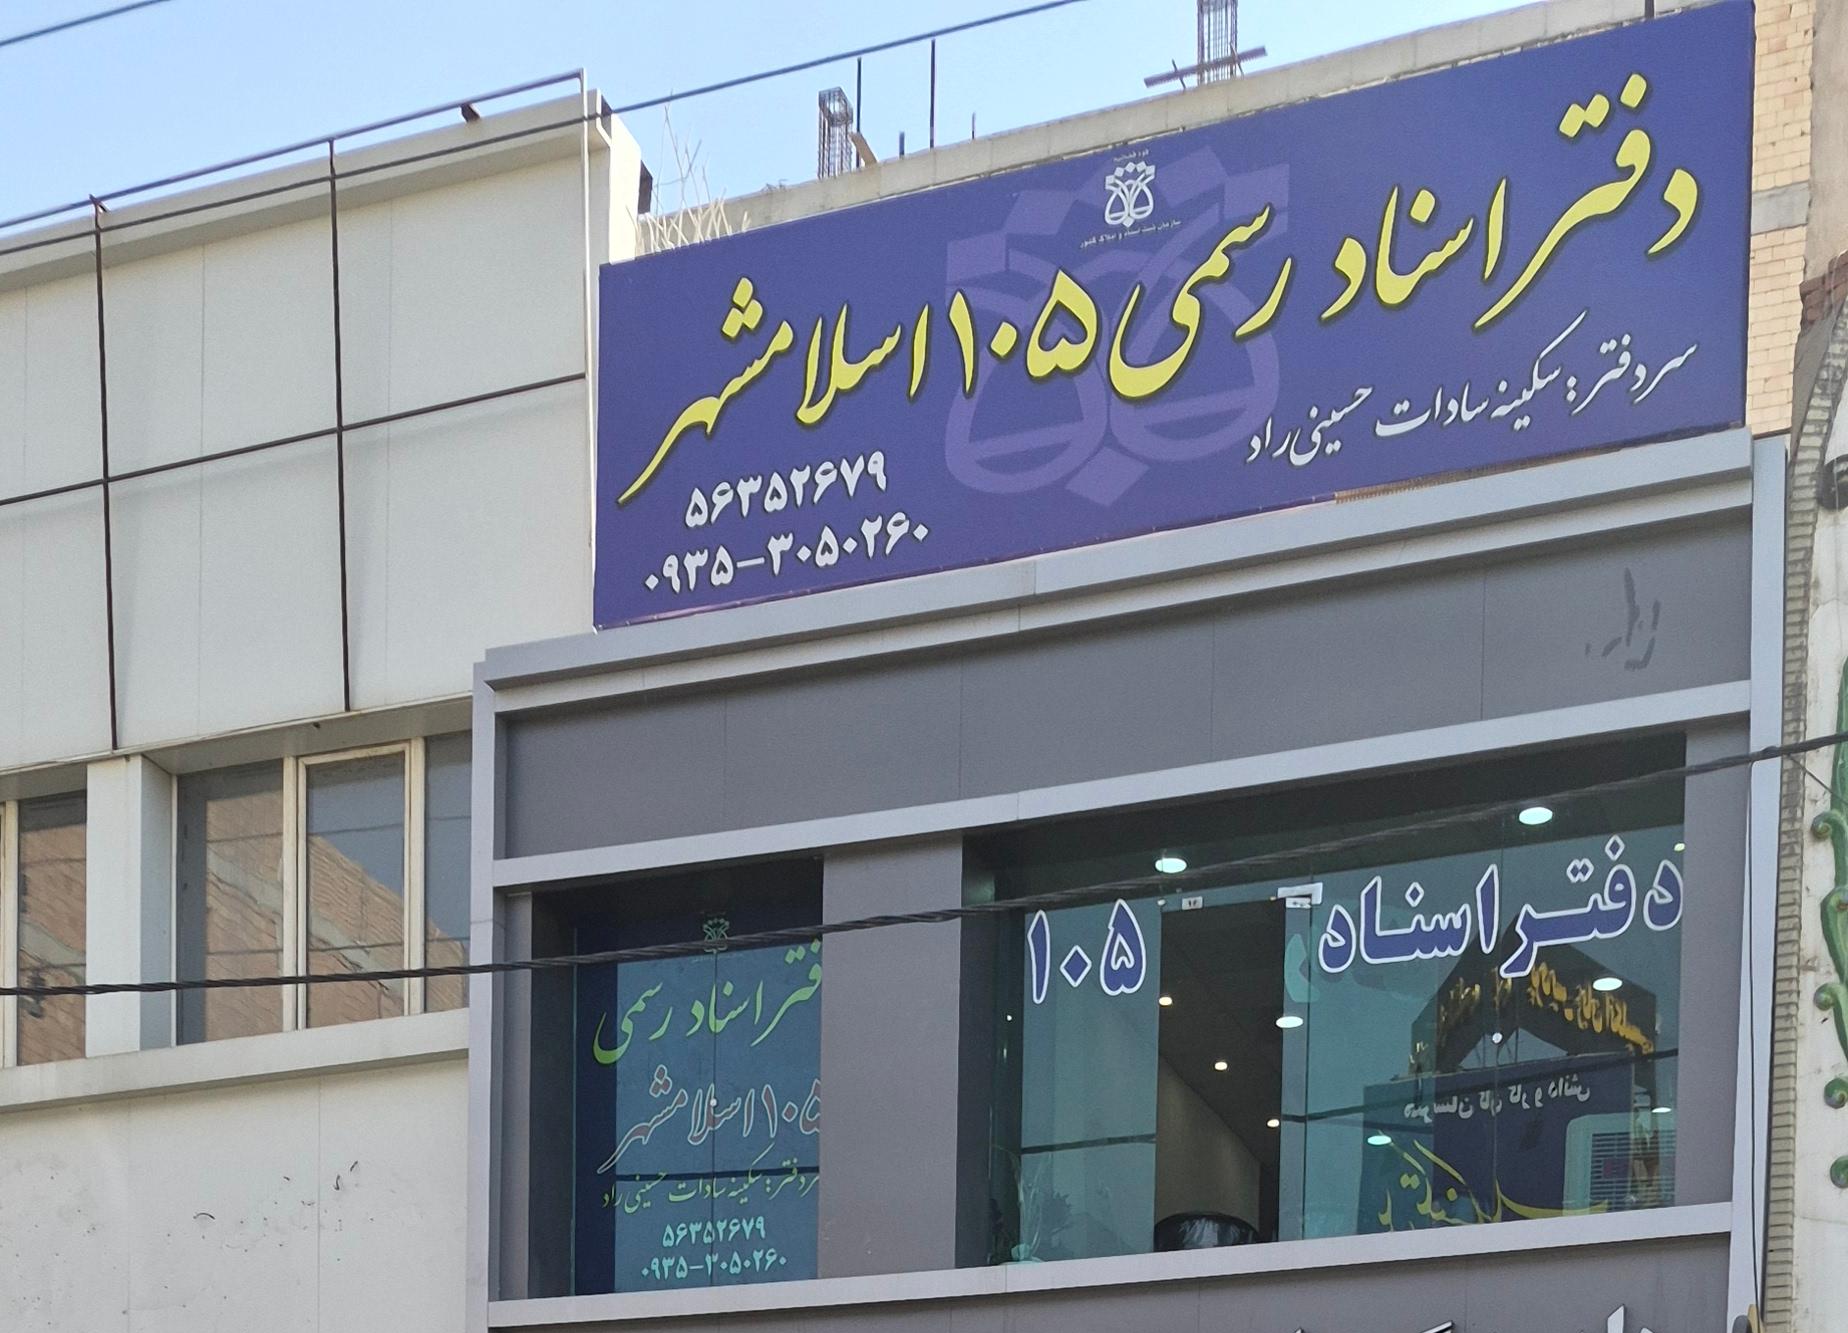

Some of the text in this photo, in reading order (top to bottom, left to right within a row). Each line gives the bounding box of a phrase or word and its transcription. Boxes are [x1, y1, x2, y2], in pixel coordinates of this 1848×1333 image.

[616, 72, 1699, 505] دفتر اسناد رسمی ۱۰۵ اسلامشهر
[1490, 309, 1589, 431] سکینه
[1244, 415, 1292, 466] راد
[1288, 384, 1375, 468] حسینی
[1374, 380, 1490, 439] سادات
[684, 449, 889, 530] ۵۶۳۵۲۶۷۹
[1026, 833, 1684, 1006] دفتر اسناد ۱۰۵
[592, 978, 675, 1066] رسمی
[685, 978, 764, 1038] اسناد
[596, 1064, 756, 1174] اسلامشهر
[624, 1170, 668, 1214] حسینی
[668, 1177, 727, 1203] سادات
[727, 1141, 776, 1205] سکینه
[662, 1215, 766, 1248] ۵۶۳۵۲۶۷۹
